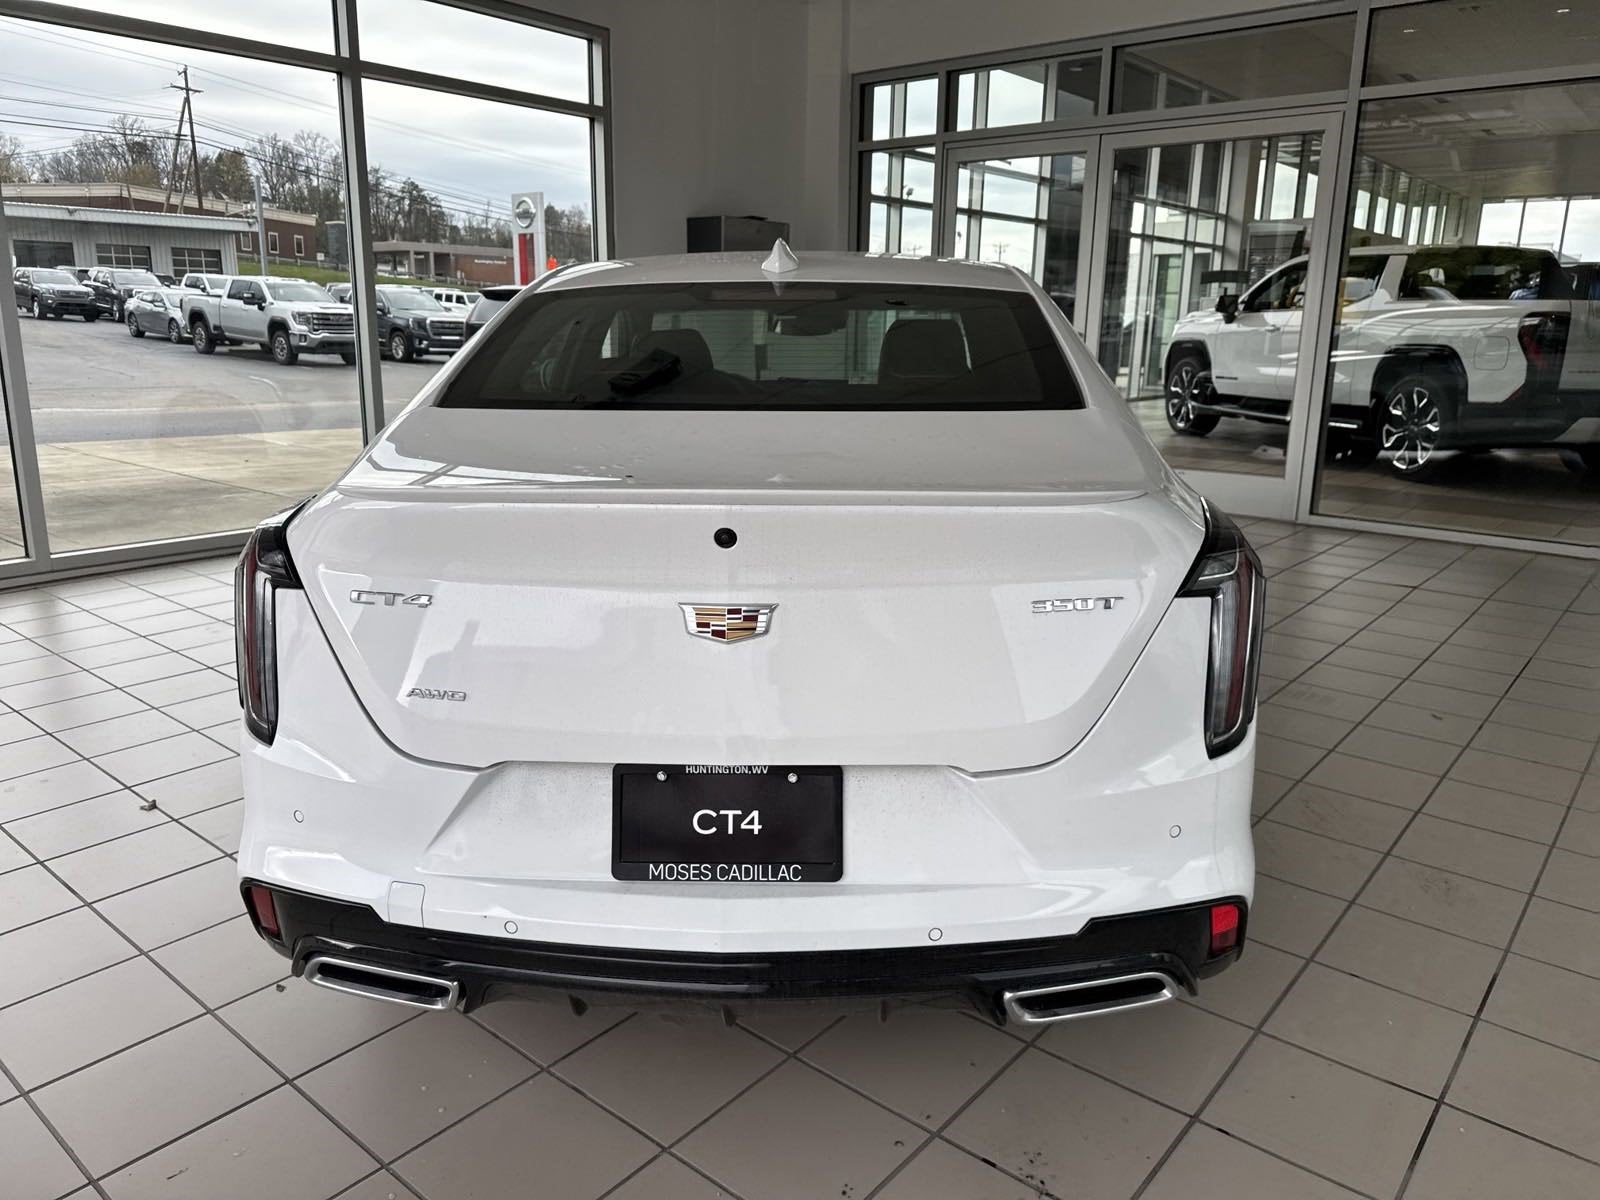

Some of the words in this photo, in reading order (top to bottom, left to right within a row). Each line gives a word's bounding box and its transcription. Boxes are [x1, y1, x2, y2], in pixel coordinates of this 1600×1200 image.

[350, 590, 433, 608] CT4
[1031, 597, 1124, 613] 350T
[407, 688, 467, 701] AWD
[692, 809, 763, 835] CT4
[649, 863, 712, 880] MOSES
[716, 864, 802, 881] CADILLAC
